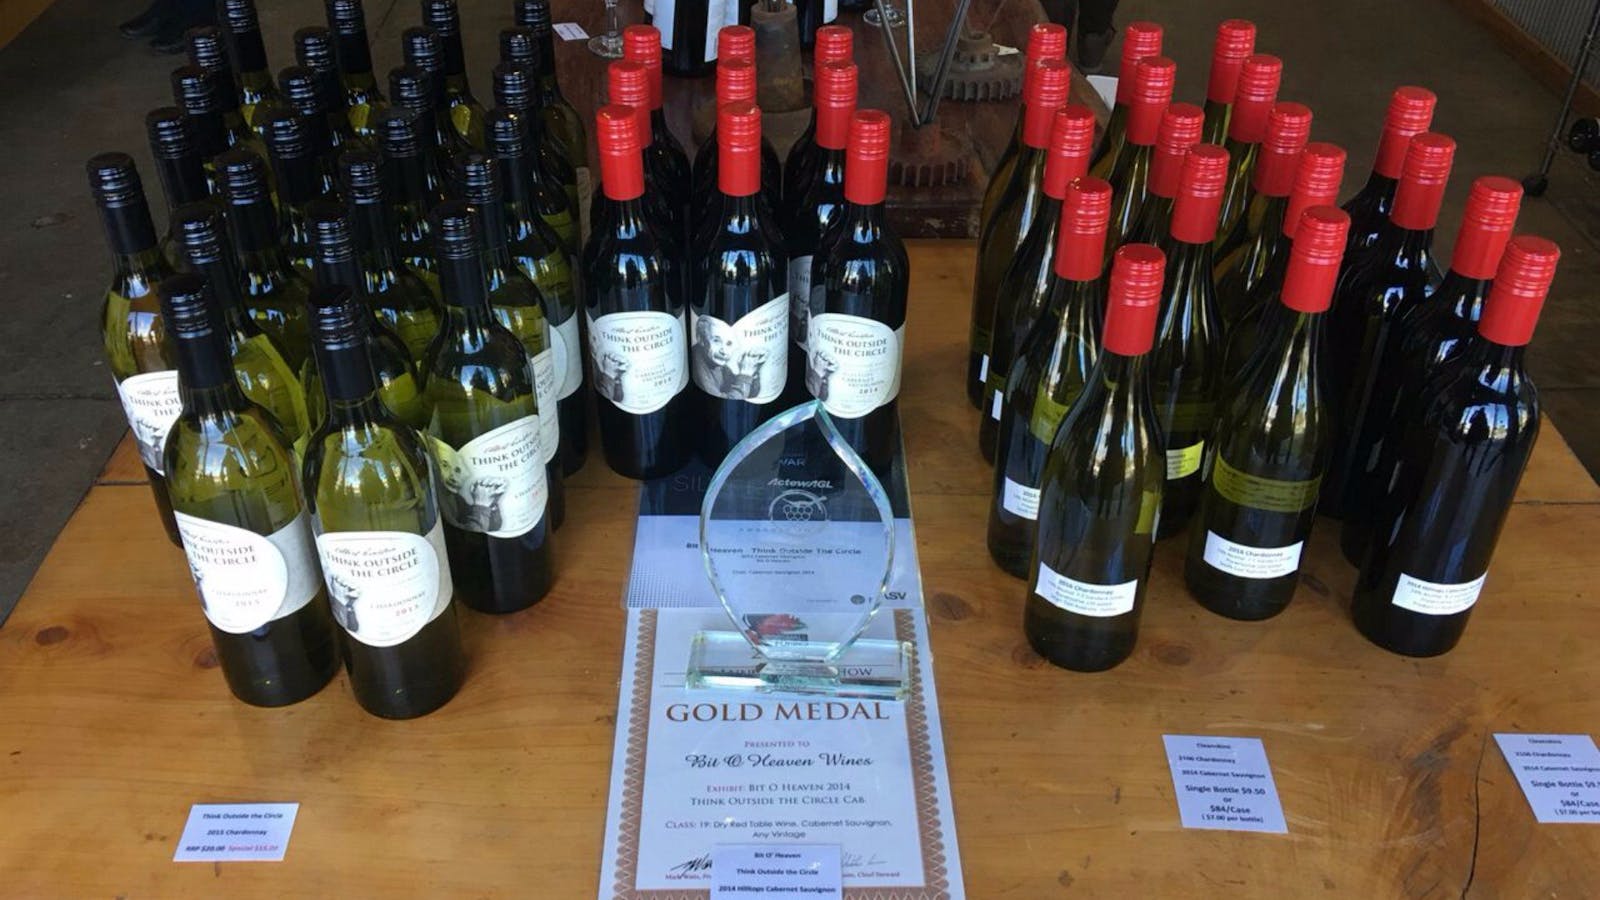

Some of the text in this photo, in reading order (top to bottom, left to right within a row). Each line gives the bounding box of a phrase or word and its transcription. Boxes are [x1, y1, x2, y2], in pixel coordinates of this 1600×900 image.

[602, 328, 673, 344] THINK OUTSIDE
[744, 327, 773, 338] THINK
[643, 336, 674, 352] CIRCLE
[818, 330, 888, 348] THINK OUTSIDE
[833, 346, 888, 357] THE CIRCLE
[472, 452, 509, 466] THINK
[498, 461, 518, 472] THE
[768, 478, 834, 489] ActewAGL
[200, 545, 254, 556] OUTSIDE
[192, 551, 257, 566] THE CIRCLE
[326, 547, 418, 568] THINK OUTSIDE
[350, 557, 420, 578] THE CIRCLE
[666, 701, 891, 722] GOLD MEDAL
[685, 752, 875, 768] Bit O Heaven Wines
[1196, 756, 1236, 764] Chardonnay
[1231, 772, 1266, 780] Sauvignon
[826, 782, 852, 792] 2014
[1530, 780, 1556, 788] Single
[1185, 784, 1266, 796] Single Bottle $9.50
[714, 820, 728, 830] Dry
[730, 820, 748, 828] Red
[749, 820, 773, 828] Table
[801, 819, 844, 828] Cabernet
[752, 830, 806, 840] Any Vintage
[718, 885, 836, 894] 2014 Hilltops Cabernet Sauvignon
